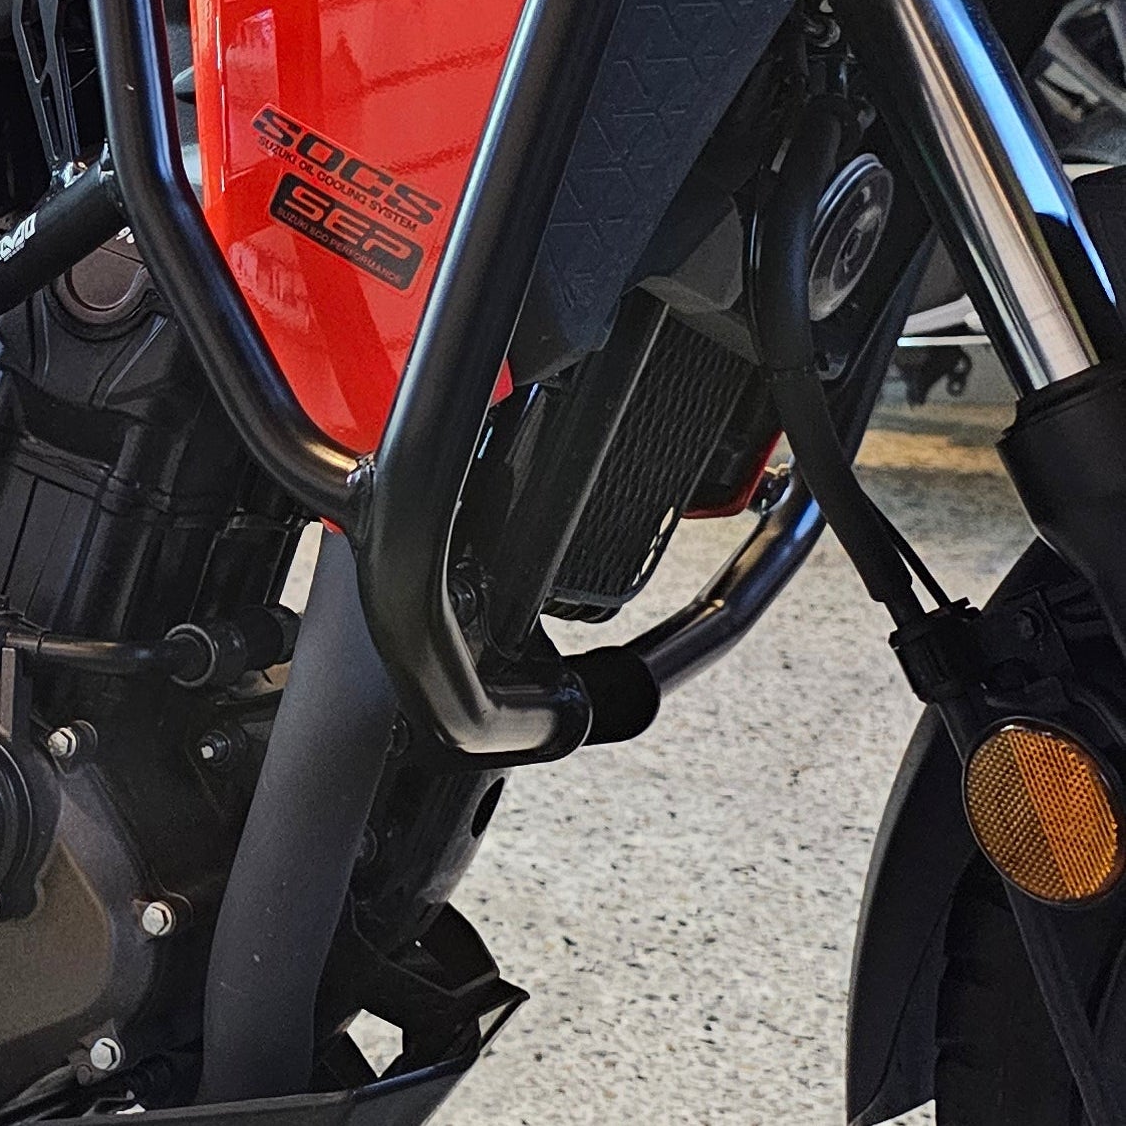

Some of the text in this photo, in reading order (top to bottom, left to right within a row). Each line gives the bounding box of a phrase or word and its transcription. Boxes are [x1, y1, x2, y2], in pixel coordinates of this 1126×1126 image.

[252, 108, 442, 225] SOCS
[258, 136, 418, 233] SUZUKI OIL COOLING SYSTEM
[276, 206, 311, 231] SUZUKI
[284, 186, 412, 260] SEP
